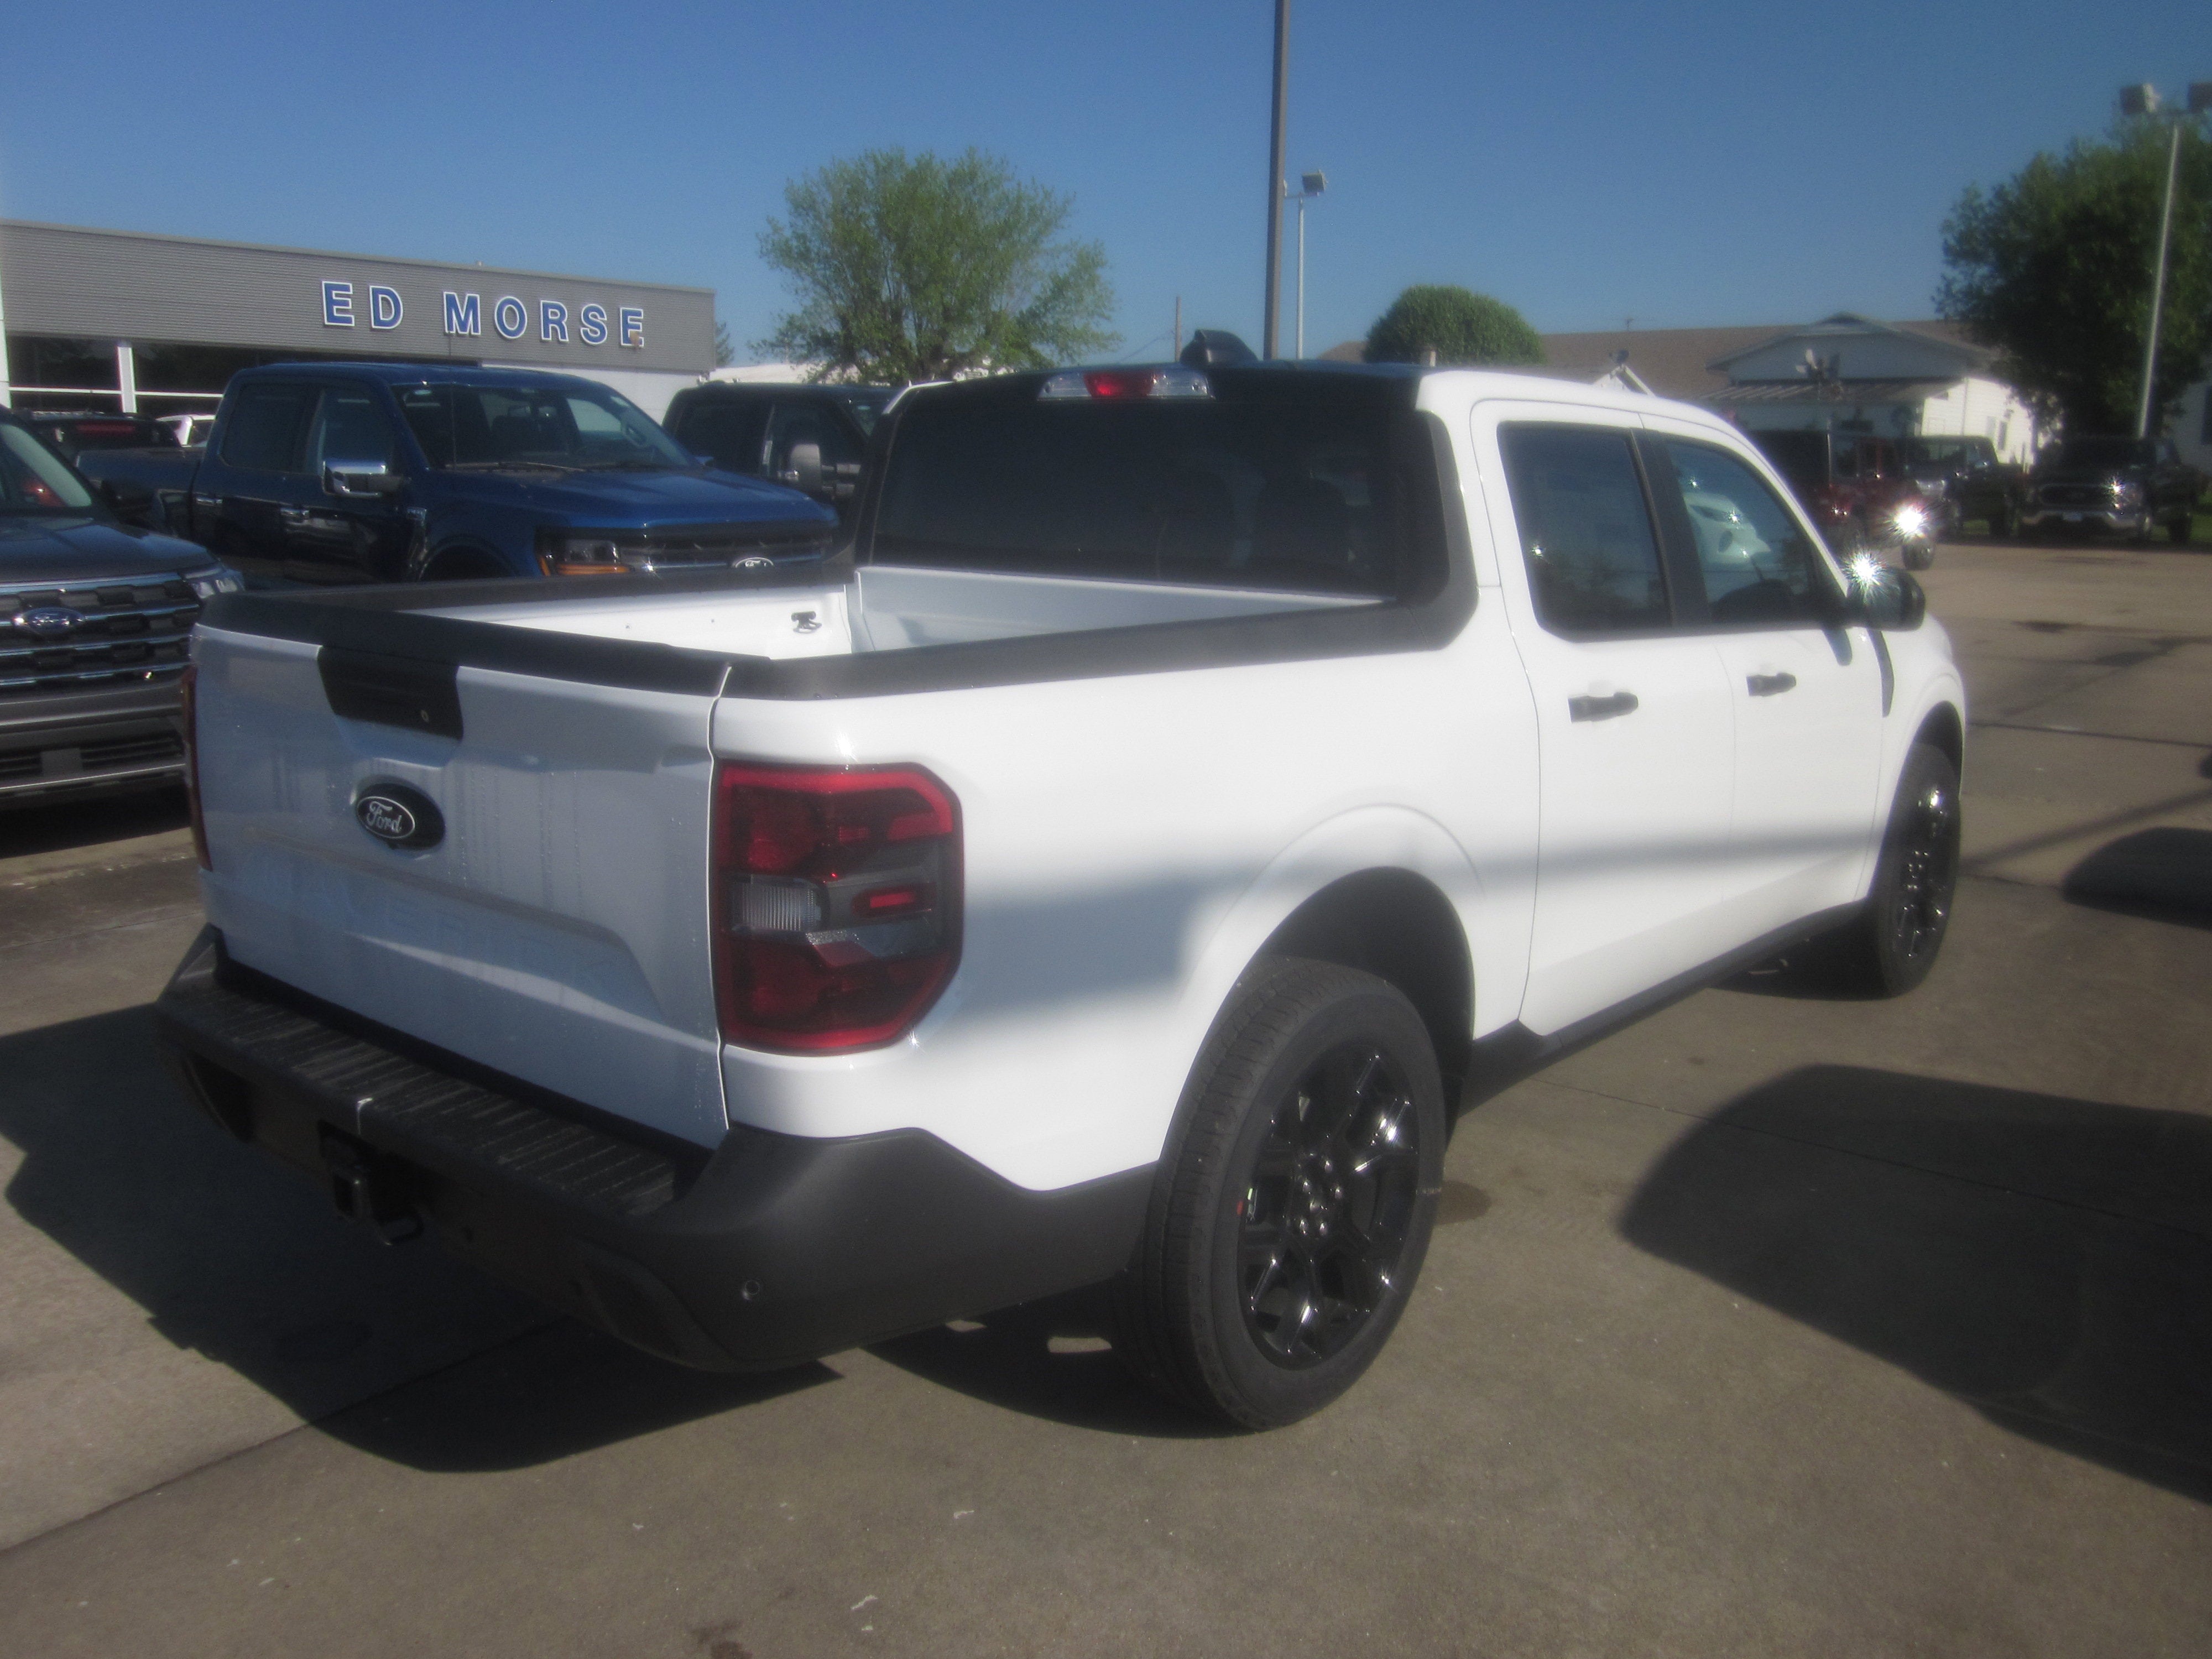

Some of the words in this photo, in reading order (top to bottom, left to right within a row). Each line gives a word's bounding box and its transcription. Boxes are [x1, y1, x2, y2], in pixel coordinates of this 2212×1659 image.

[322, 280, 404, 329] ED
[443, 291, 645, 348] MORSE
[366, 801, 403, 833] Ford
